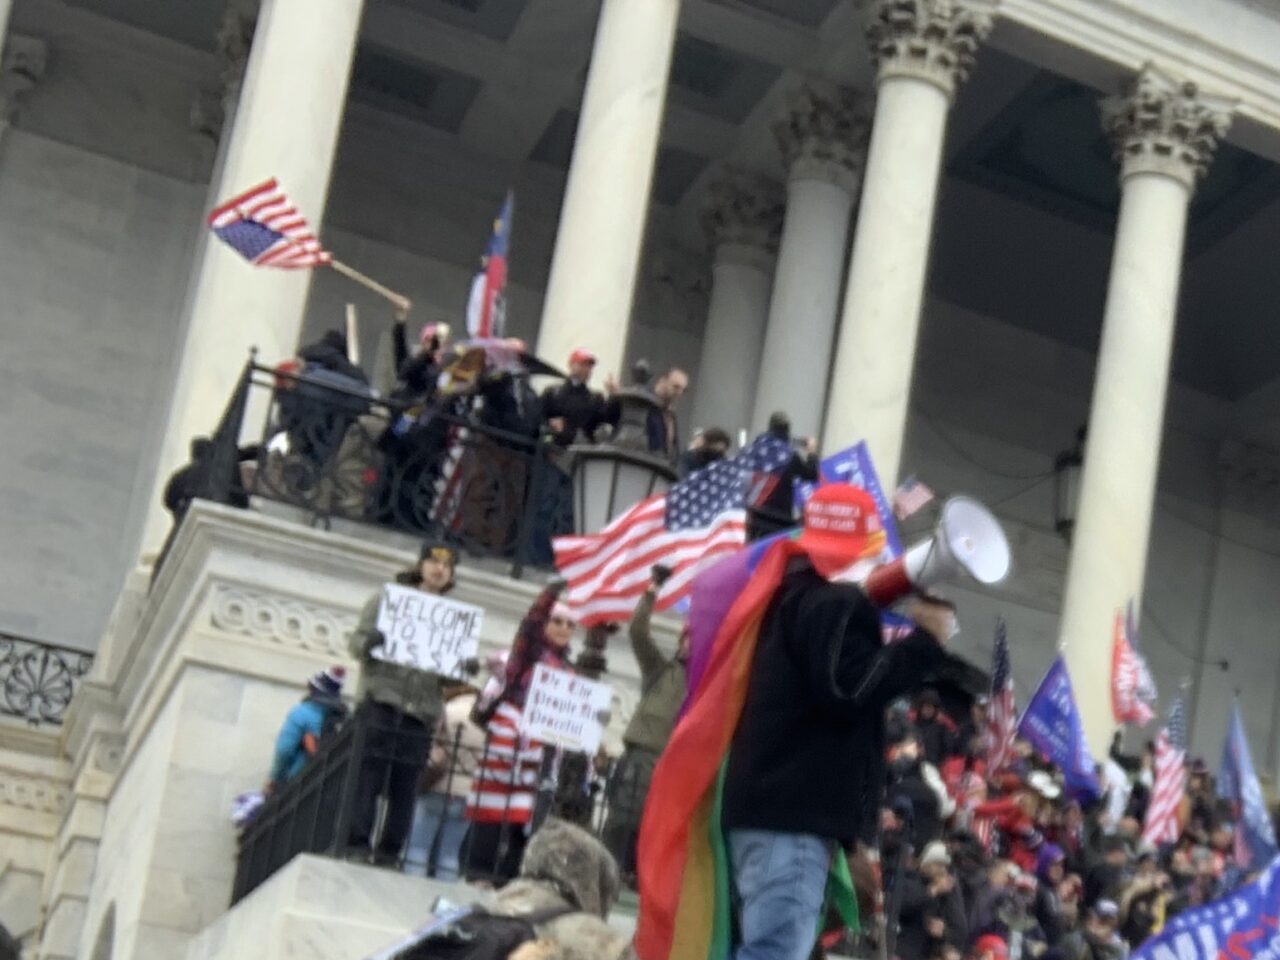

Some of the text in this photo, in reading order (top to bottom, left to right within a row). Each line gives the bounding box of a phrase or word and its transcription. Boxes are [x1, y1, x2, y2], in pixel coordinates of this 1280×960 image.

[385, 594, 478, 639] WELCOME
[390, 617, 466, 656] TO THE
